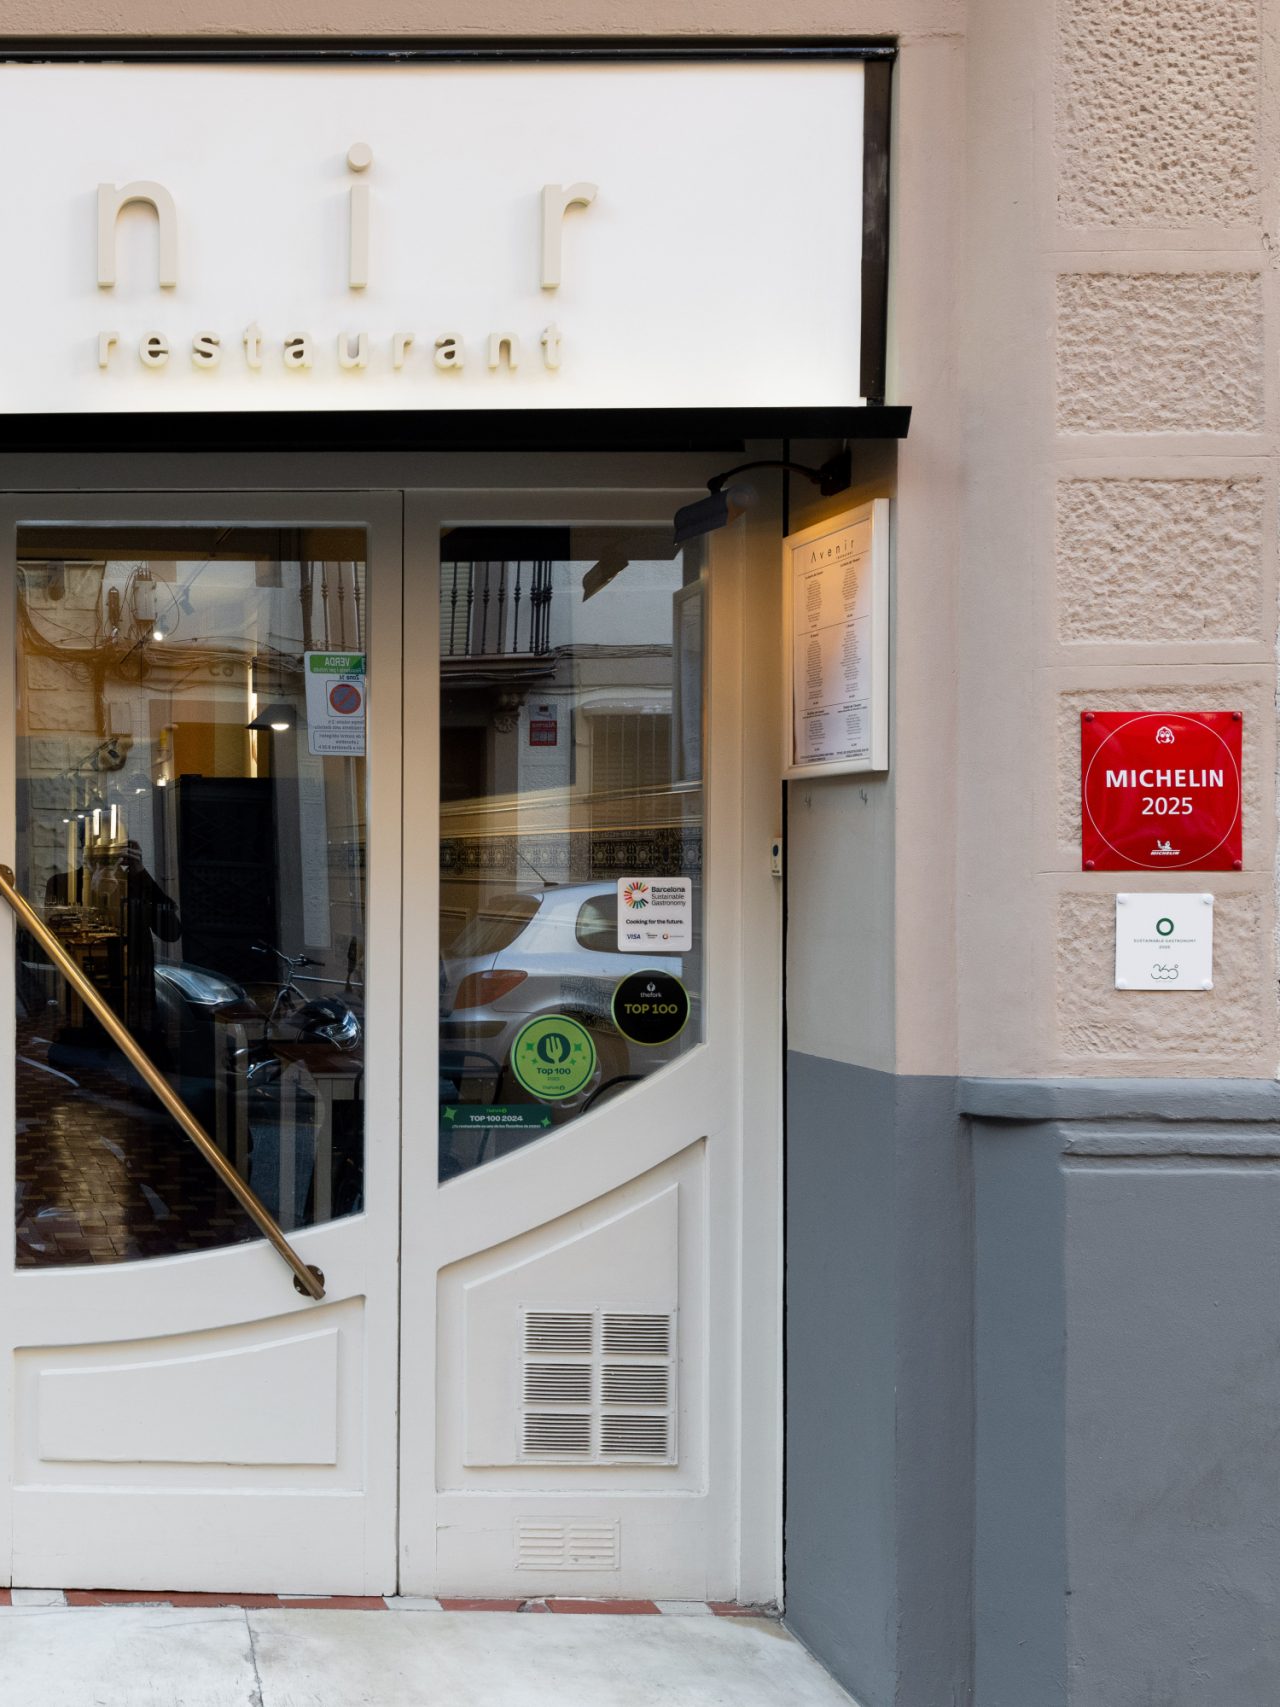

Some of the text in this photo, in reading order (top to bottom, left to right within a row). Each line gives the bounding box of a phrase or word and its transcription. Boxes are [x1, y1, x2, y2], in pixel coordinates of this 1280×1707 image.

[97, 322, 562, 370] restaurant
[810, 538, 855, 564] Avenir
[1106, 769, 1224, 788] MICHELIN
[1141, 797, 1193, 815] 2025
[624, 1003, 678, 1014] TOP 100
[536, 1067, 571, 1075] Top 100
